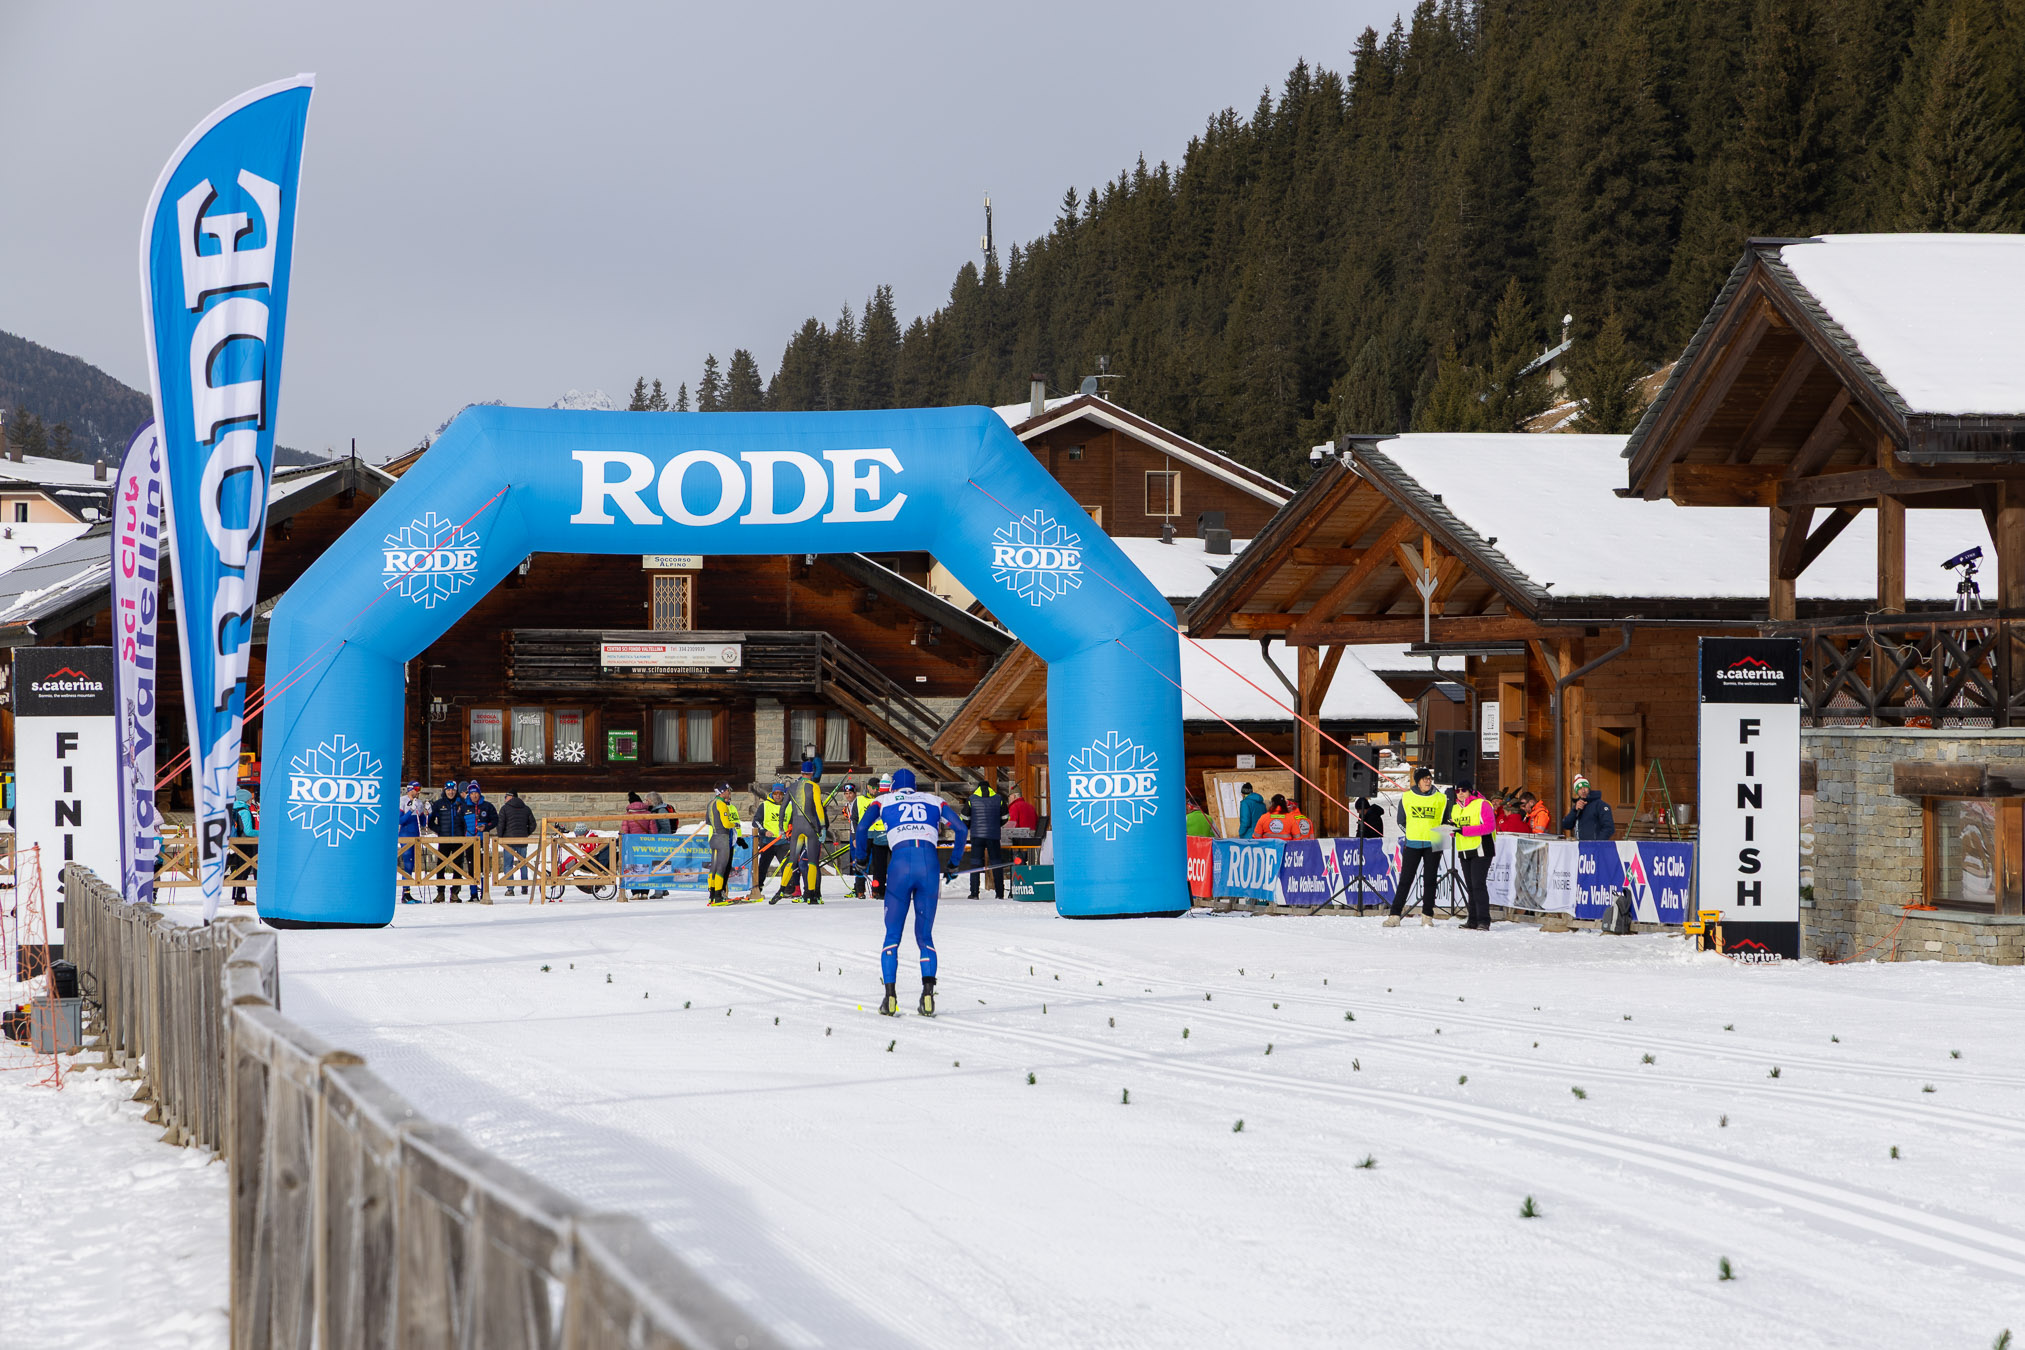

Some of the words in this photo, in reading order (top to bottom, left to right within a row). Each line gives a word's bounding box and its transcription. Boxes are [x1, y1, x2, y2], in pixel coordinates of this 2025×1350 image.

[177, 168, 281, 715] RODE
[570, 448, 908, 527] RODE
[122, 475, 140, 579] Club
[383, 550, 478, 572] RODE
[992, 545, 1082, 570] RODE
[121, 597, 136, 664] Sci
[632, 666, 710, 674] www.scifondovaltellina.it
[1716, 666, 1785, 680] s.caterina
[31, 677, 104, 691] s.caterina
[289, 776, 381, 804] RODE
[1068, 772, 1157, 798] RODE
[898, 803, 928, 822] 26
[1737, 718, 1763, 906] FINISH
[896, 825, 925, 833] SACMA
[1227, 846, 1278, 891] RODE
[1284, 851, 1292, 868] Sci
[1343, 849, 1352, 866] Sci
[1653, 856, 1666, 876] Sci
[1667, 855, 1685, 877] Club
[1287, 875, 1298, 893] Alta
[1299, 875, 1325, 893] Valtellina
[1661, 887, 1679, 909] Alta
